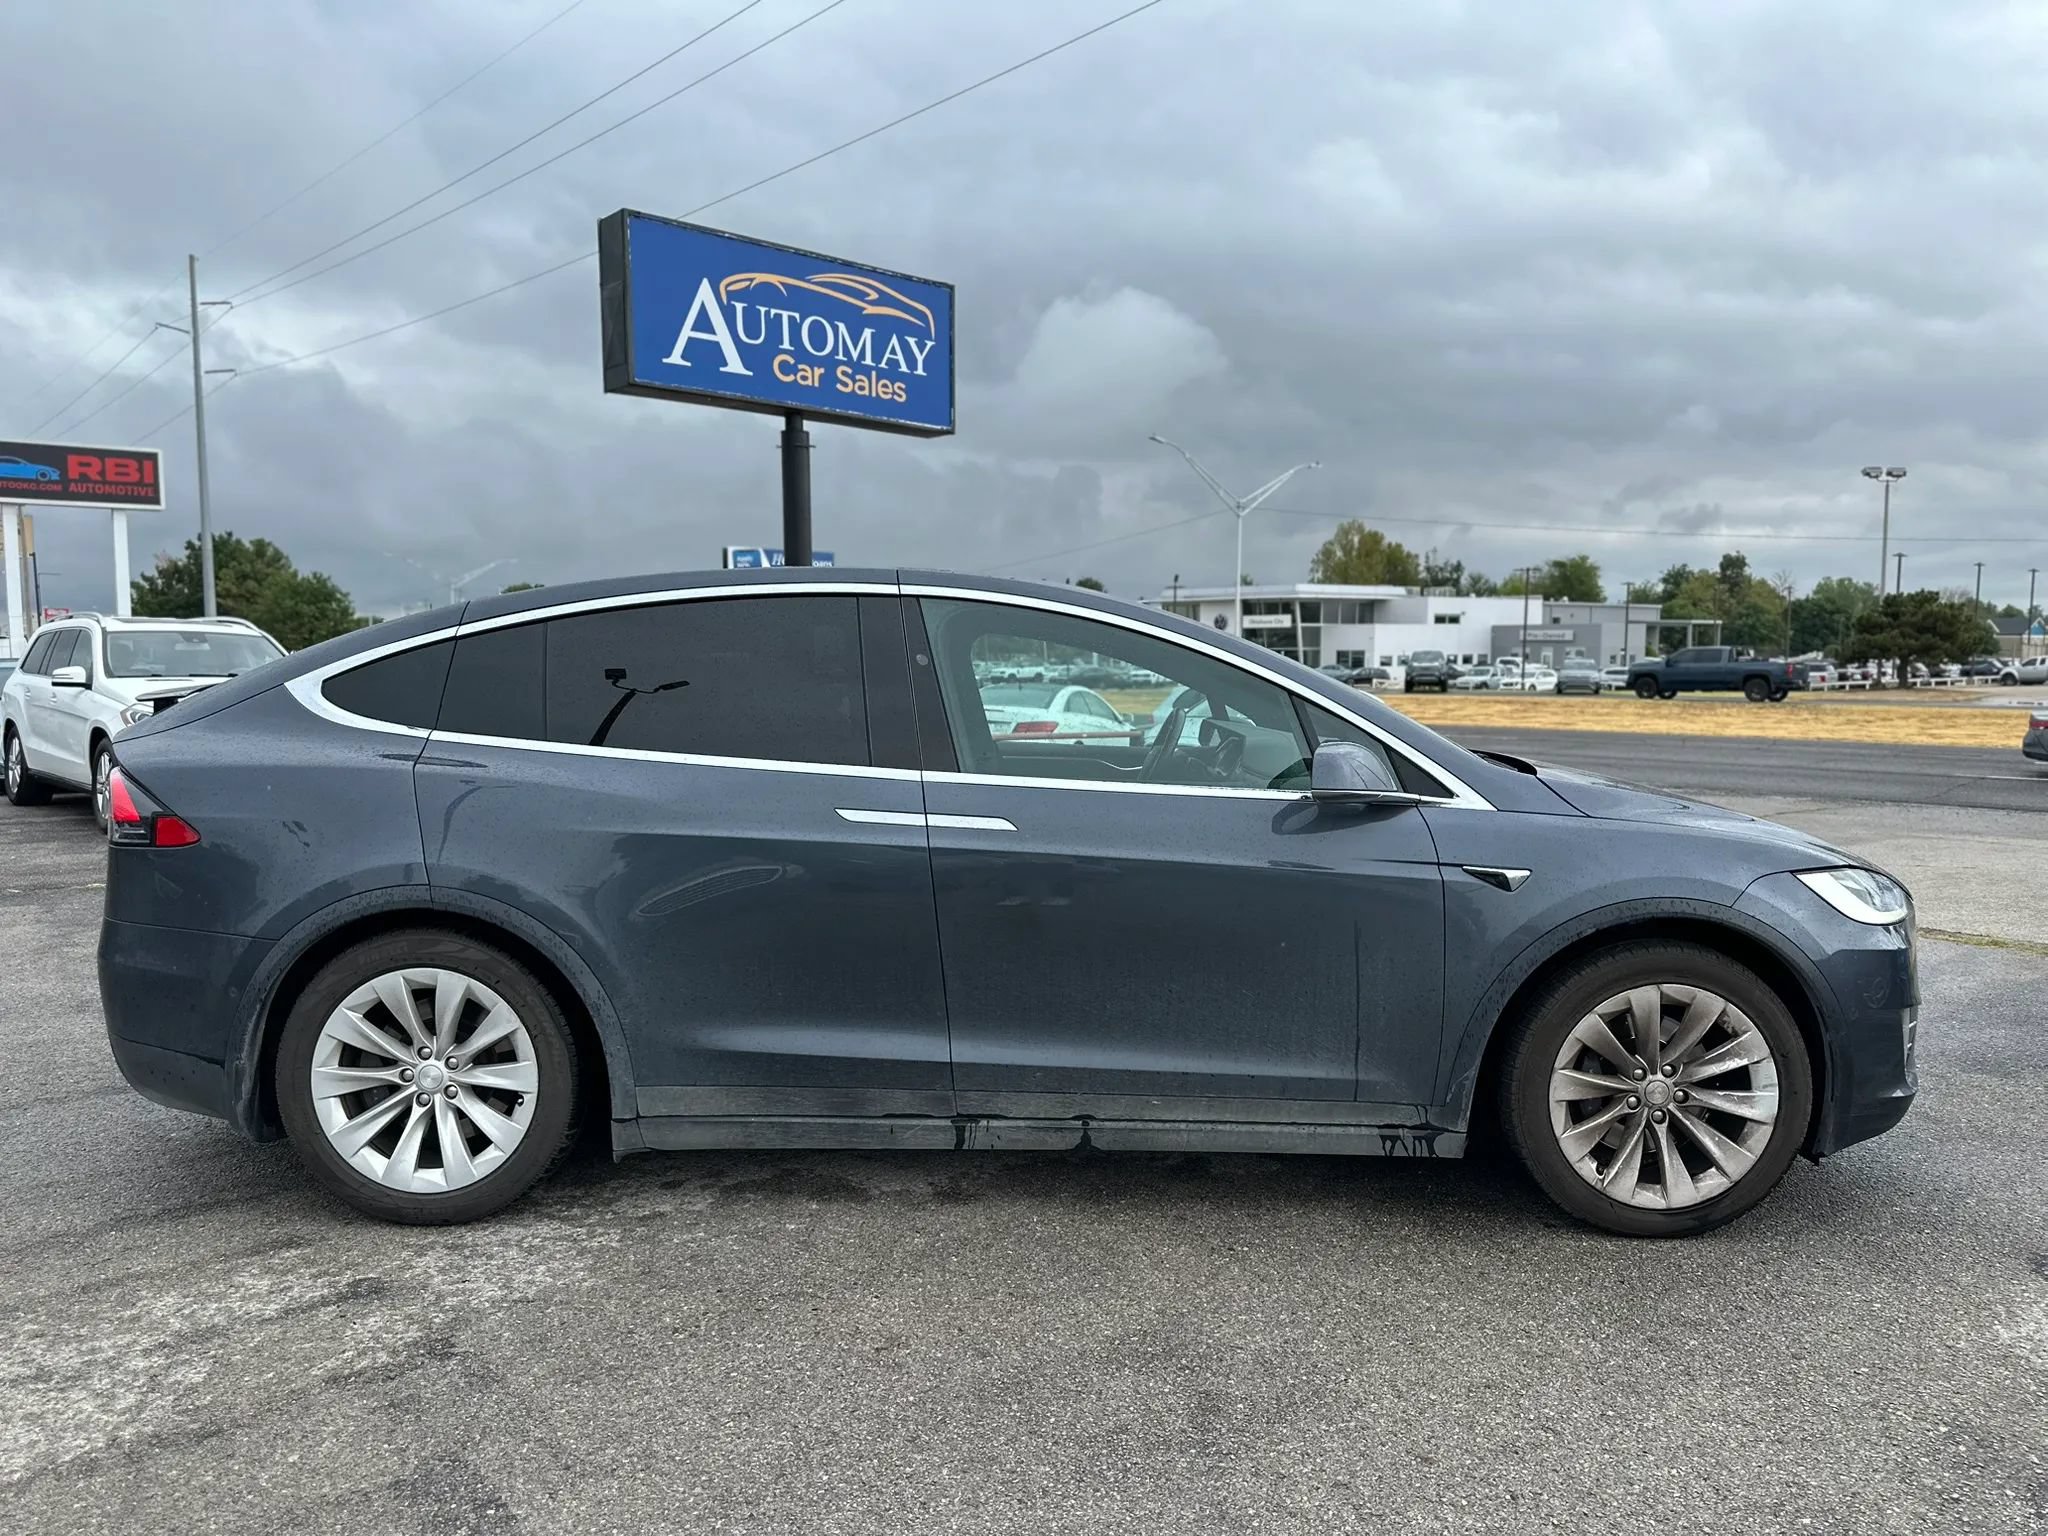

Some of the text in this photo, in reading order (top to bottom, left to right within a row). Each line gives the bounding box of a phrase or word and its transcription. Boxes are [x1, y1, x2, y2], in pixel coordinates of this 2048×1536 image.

[662, 277, 936, 377] AUTOMAY
[772, 354, 907, 403] Car Sales
[67, 454, 155, 484] RBI
[69, 483, 155, 497] AUTOMOTIVE
